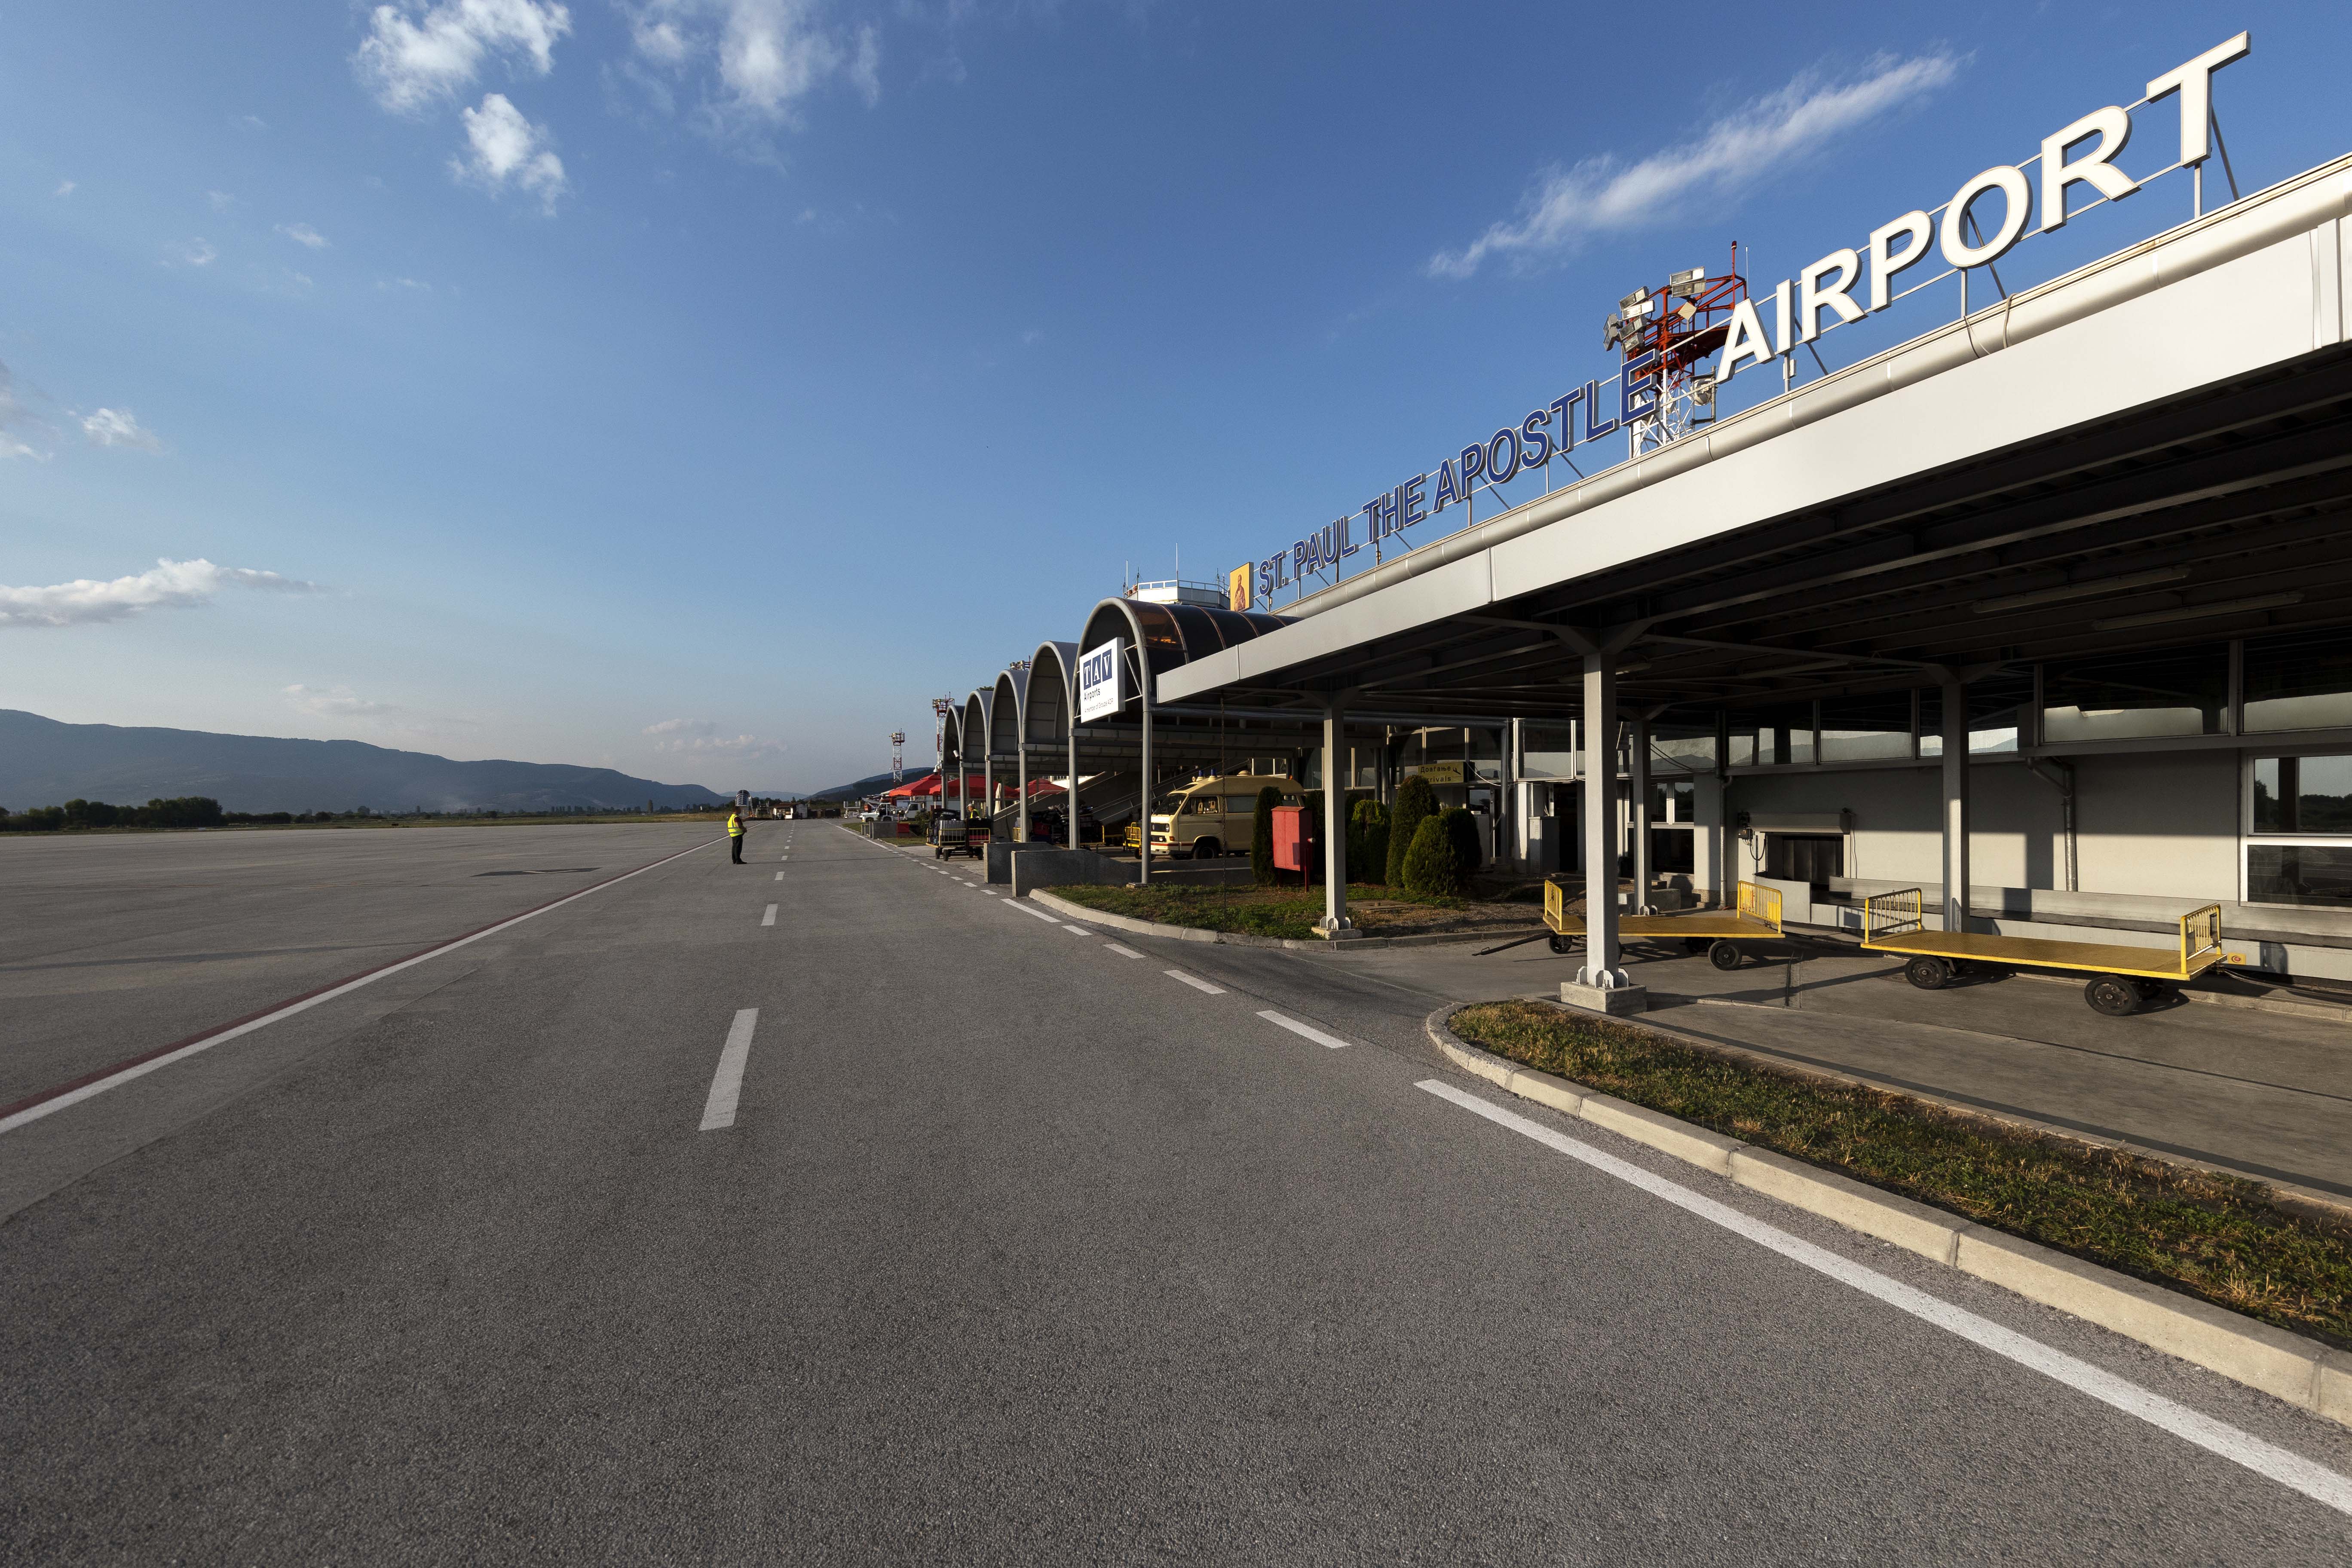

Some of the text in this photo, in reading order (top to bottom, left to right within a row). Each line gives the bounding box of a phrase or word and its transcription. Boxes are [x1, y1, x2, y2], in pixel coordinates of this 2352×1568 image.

[1259, 30, 2251, 596] ST. PAUL THE APOSTLE AIRPORT
[1084, 654, 1111, 686] TAV
[1084, 688, 1100, 701] Airports
